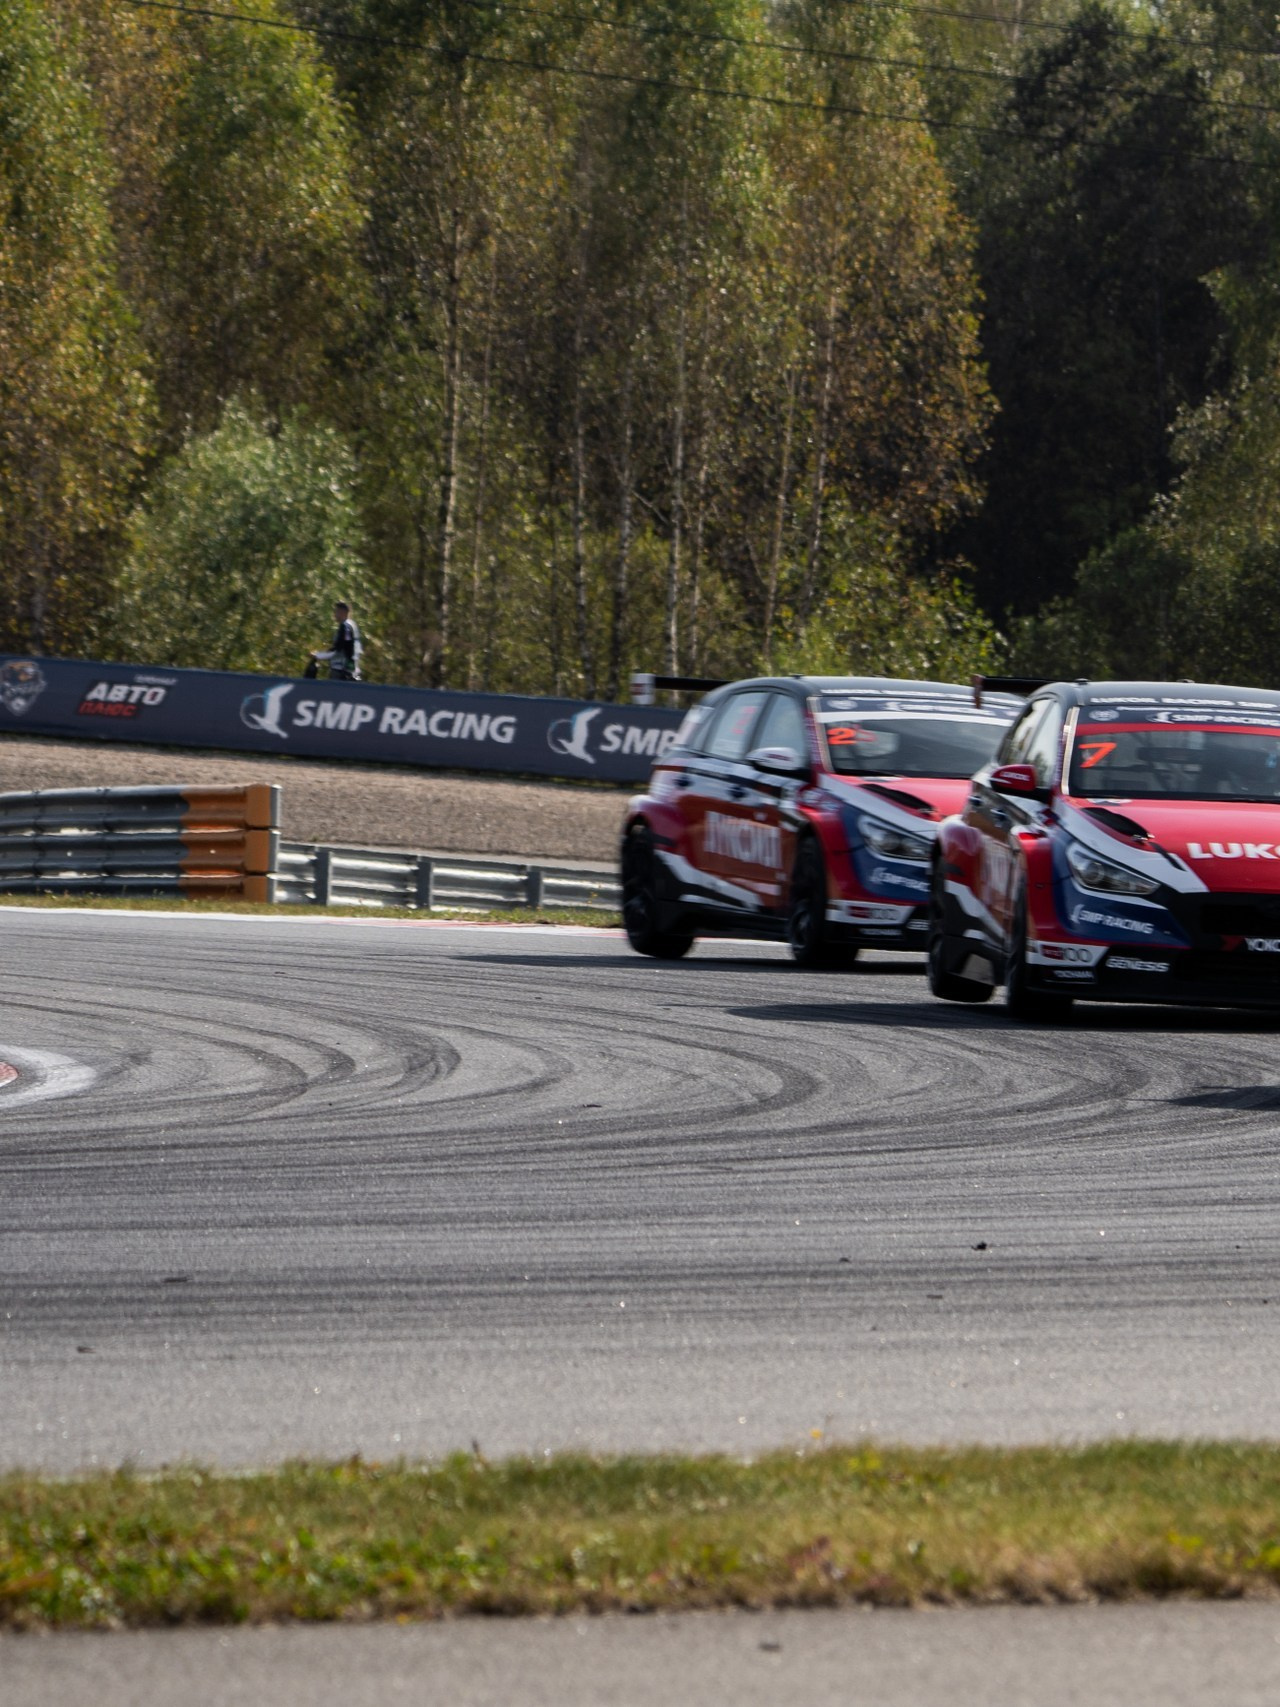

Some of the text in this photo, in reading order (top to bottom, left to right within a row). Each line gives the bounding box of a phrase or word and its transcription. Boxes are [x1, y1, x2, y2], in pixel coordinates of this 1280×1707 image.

[86, 682, 166, 706] АВТО
[293, 700, 517, 744] SMP RACING
[827, 727, 857, 745] 2
[1078, 742, 1117, 768] 7
[1105, 956, 1171, 972] GENESIS
